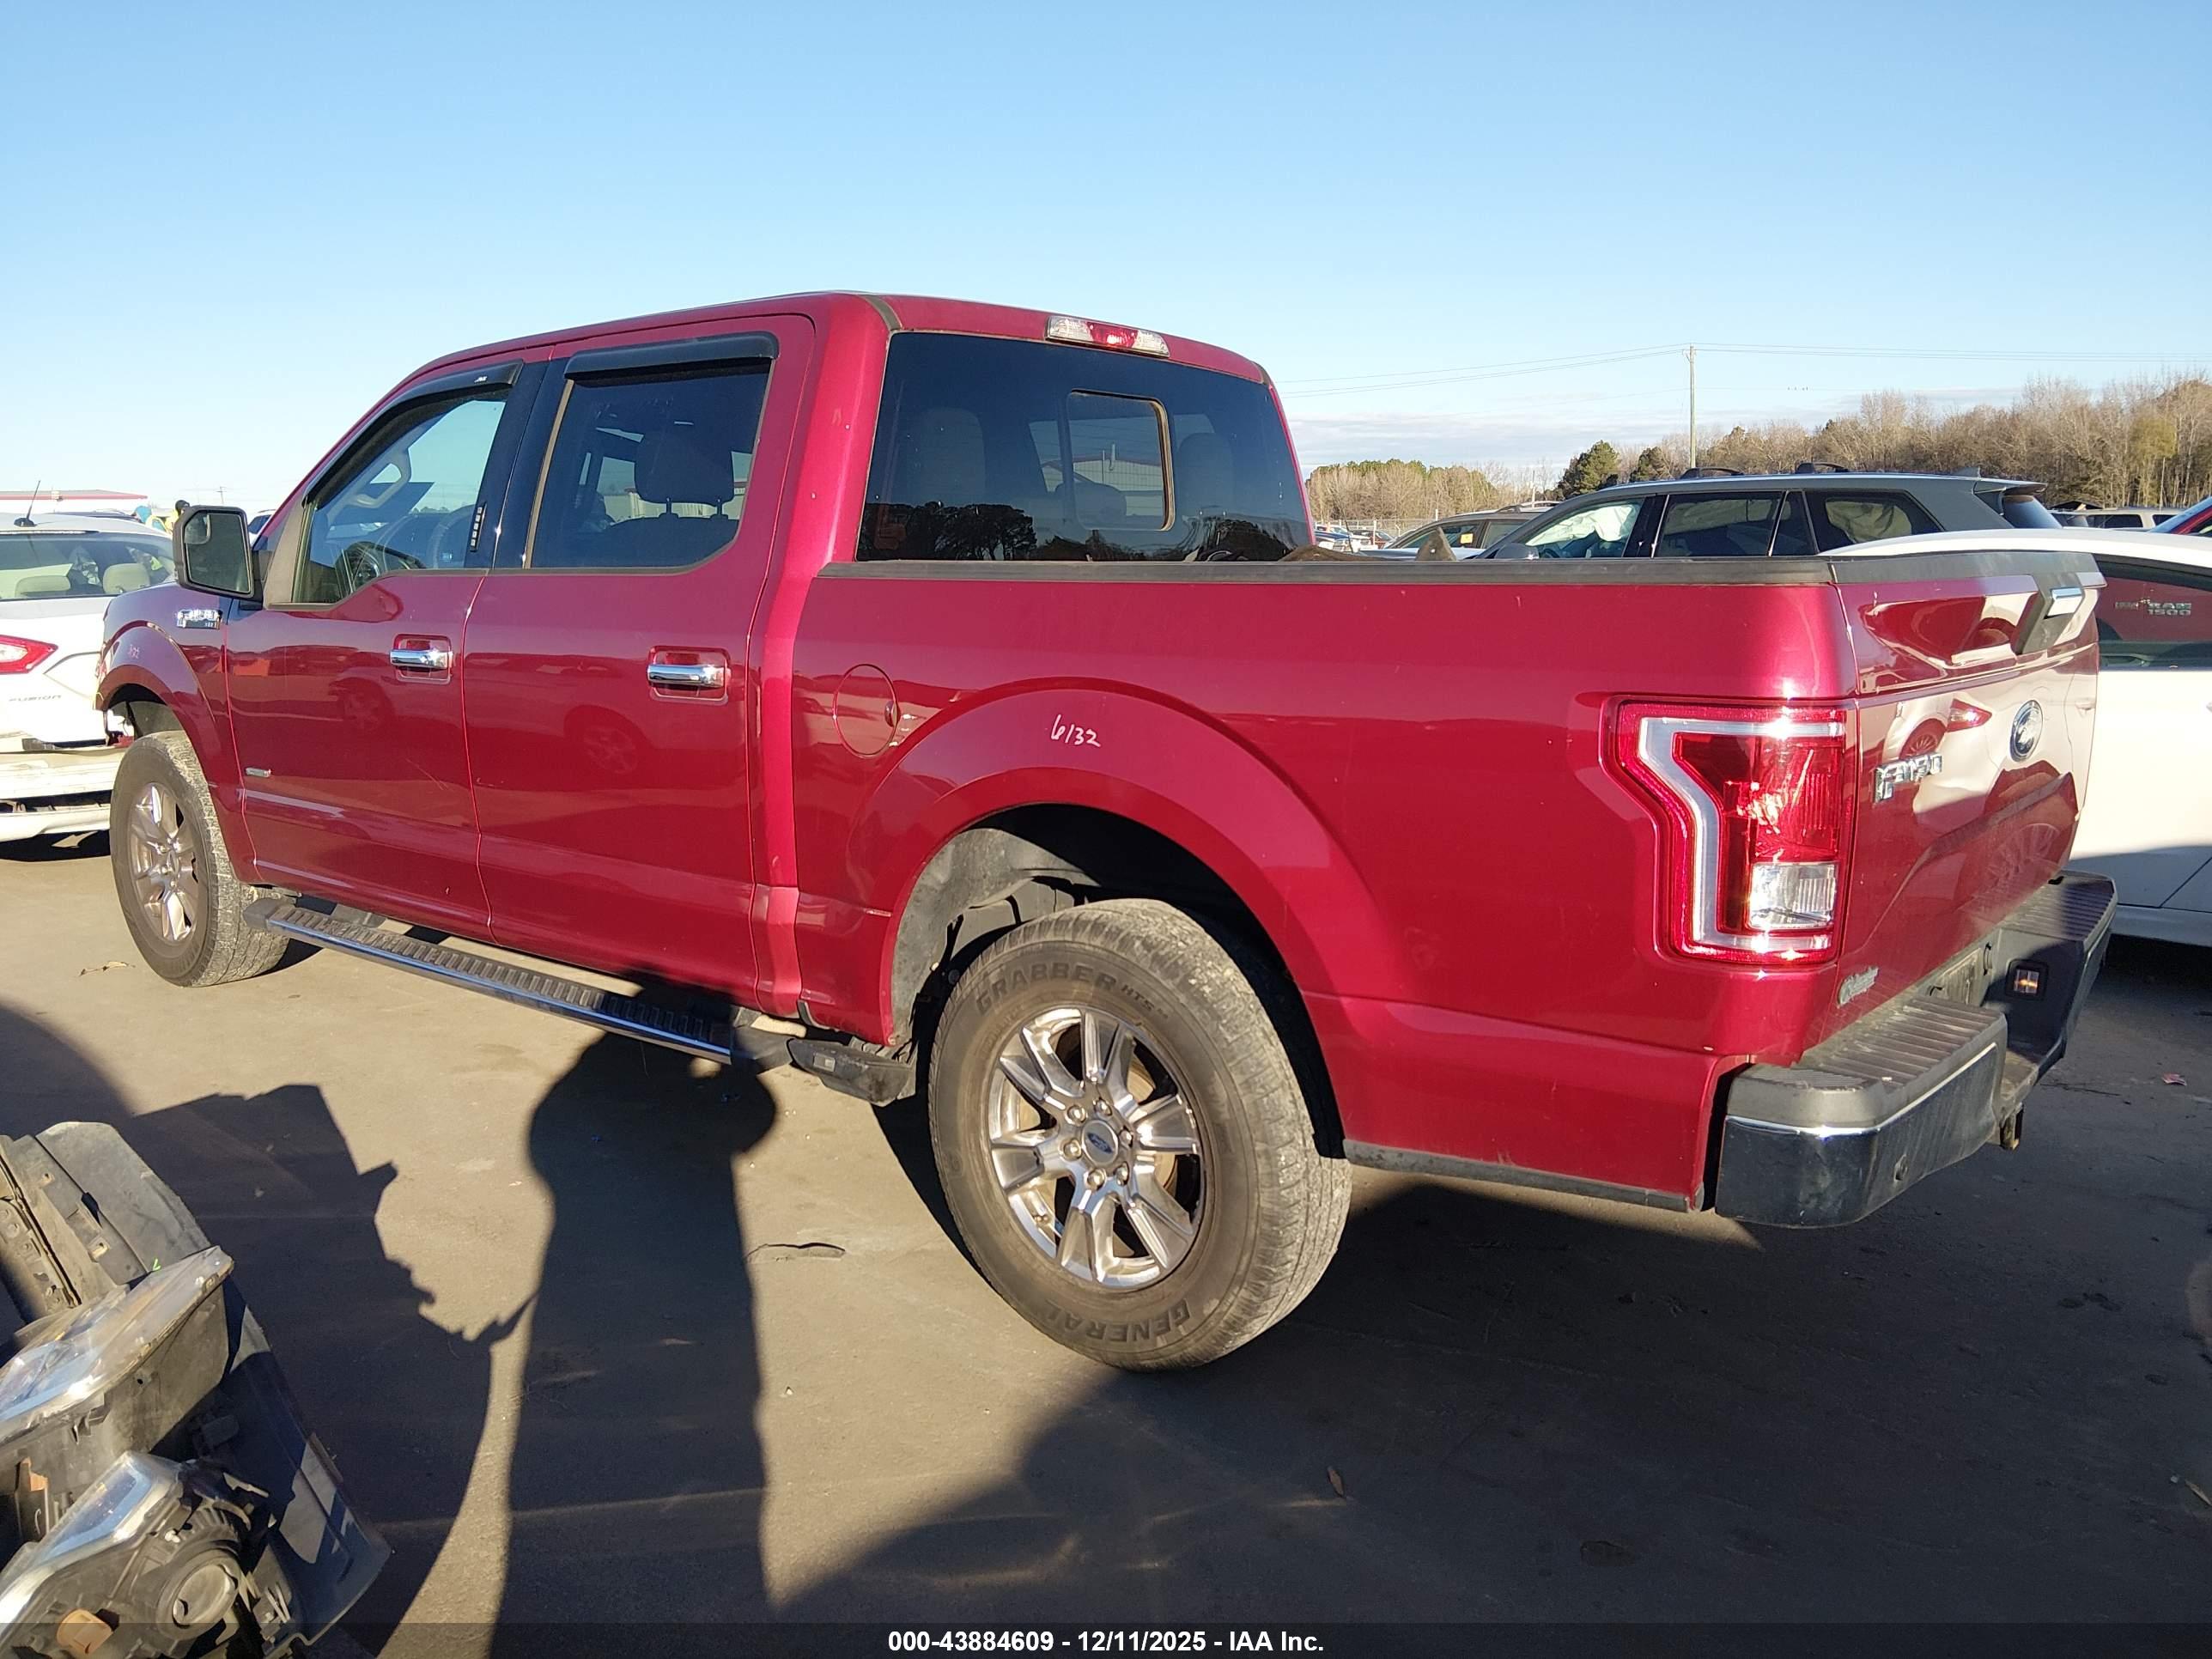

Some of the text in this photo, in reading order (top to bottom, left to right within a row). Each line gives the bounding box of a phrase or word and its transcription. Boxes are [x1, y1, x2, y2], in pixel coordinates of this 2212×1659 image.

[1051, 714, 1101, 747] 6132
[975, 961, 1117, 1015] GRABBER
[1044, 1297, 1191, 1343] GENERAL
